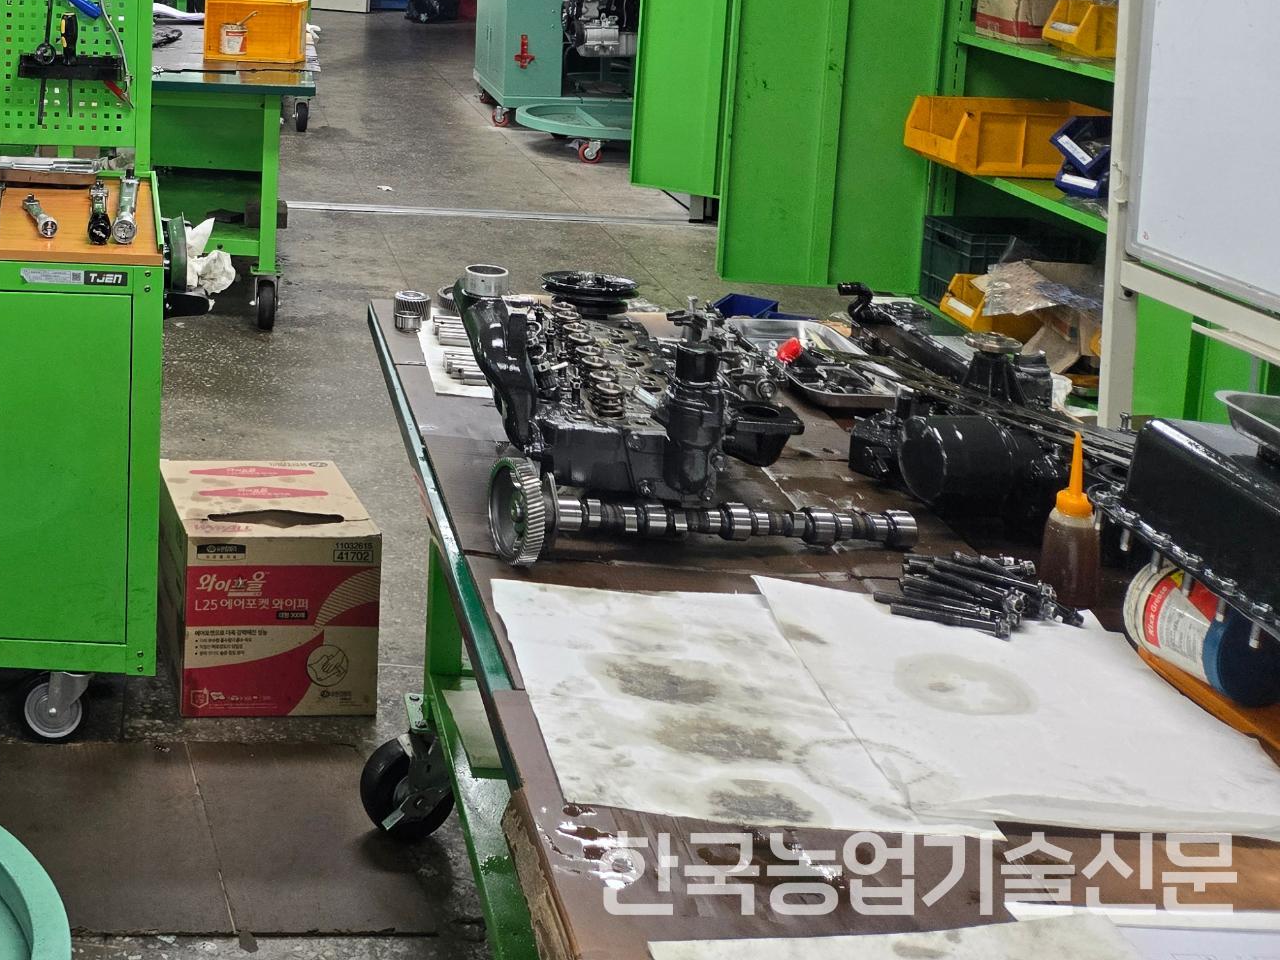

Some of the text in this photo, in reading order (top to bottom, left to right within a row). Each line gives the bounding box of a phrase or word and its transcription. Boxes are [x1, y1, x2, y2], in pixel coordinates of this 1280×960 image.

[337, 551, 370, 561] 41702
[194, 598, 309, 612] L25 에어포켓 와이퍼
